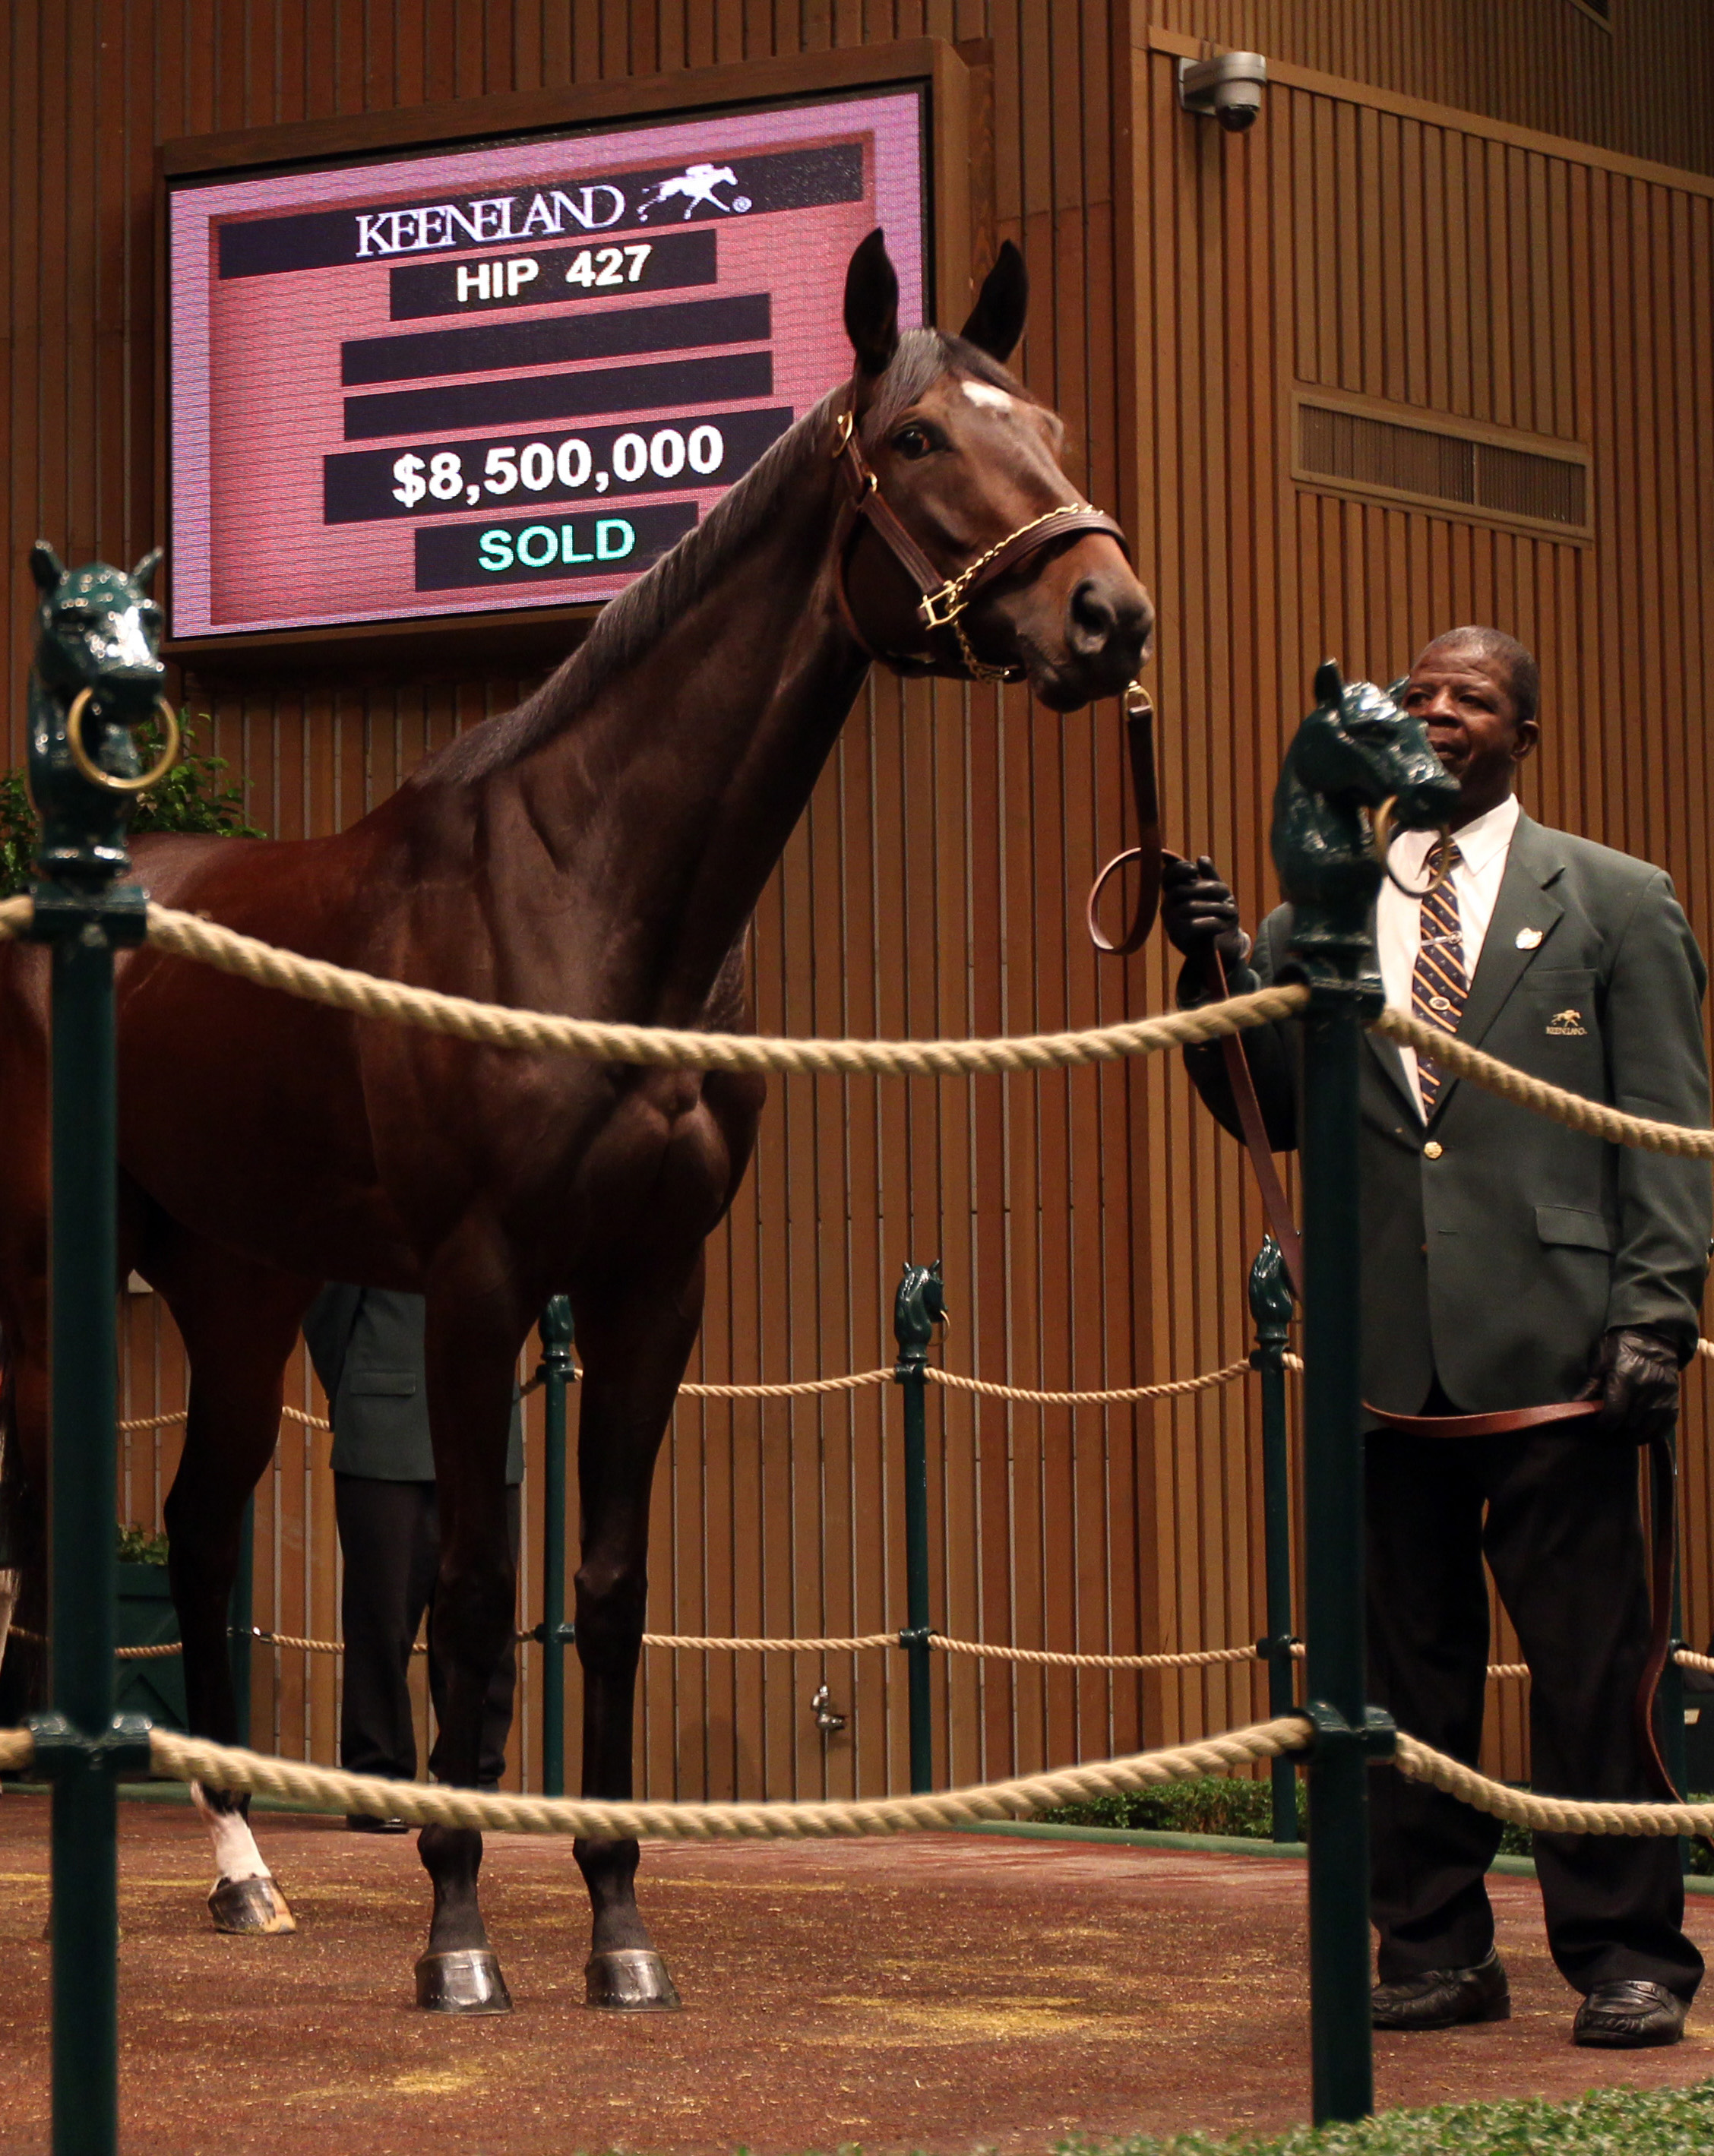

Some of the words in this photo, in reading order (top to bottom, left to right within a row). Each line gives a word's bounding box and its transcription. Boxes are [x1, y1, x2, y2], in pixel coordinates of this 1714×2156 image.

[356, 185, 625, 257] KEENELAND
[457, 258, 539, 302] HIP
[565, 244, 651, 287] 427
[392, 425, 724, 507] $8,500,000
[478, 518, 635, 571] SOLD
